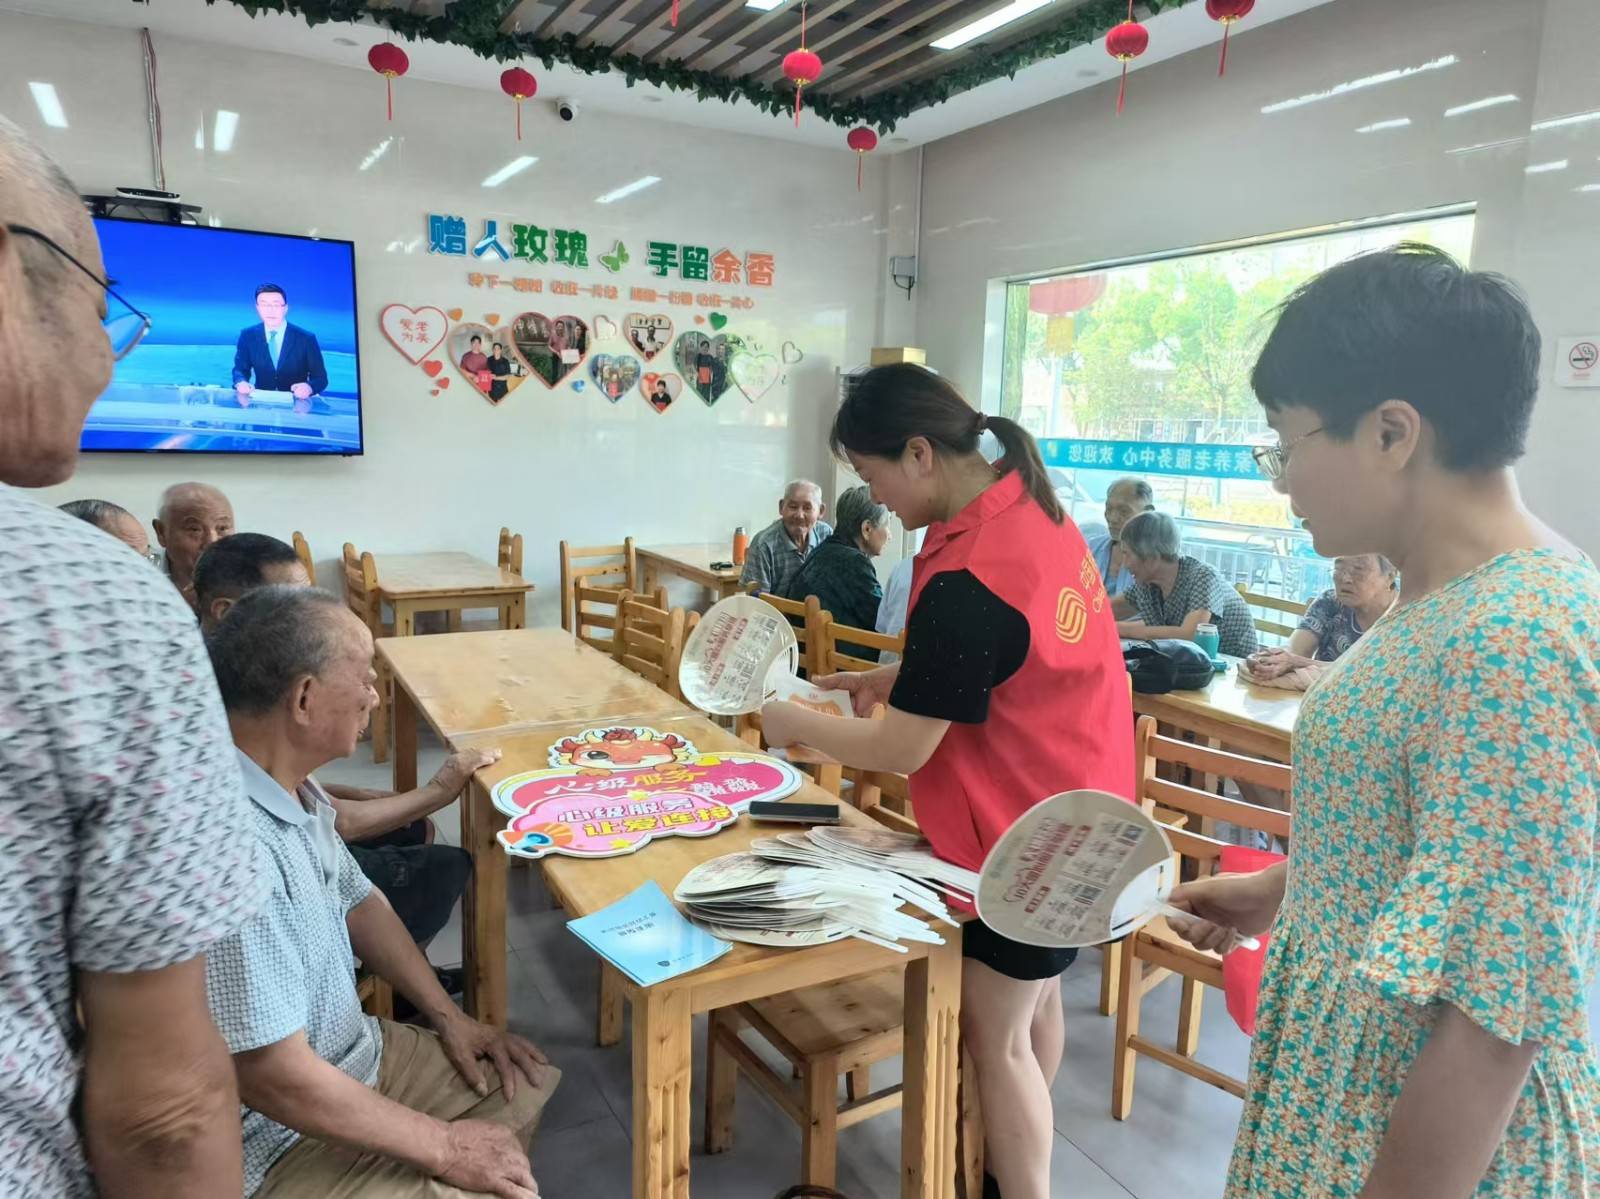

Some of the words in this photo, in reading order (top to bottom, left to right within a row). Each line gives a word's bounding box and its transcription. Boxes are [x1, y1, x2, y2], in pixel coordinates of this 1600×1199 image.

[428, 212, 590, 269] 赠人玫瑰
[646, 241, 776, 287] 手留余香
[545, 771, 707, 795] 心级服务
[560, 797, 694, 823] 心级服务
[584, 806, 732, 836] 让爱连接
